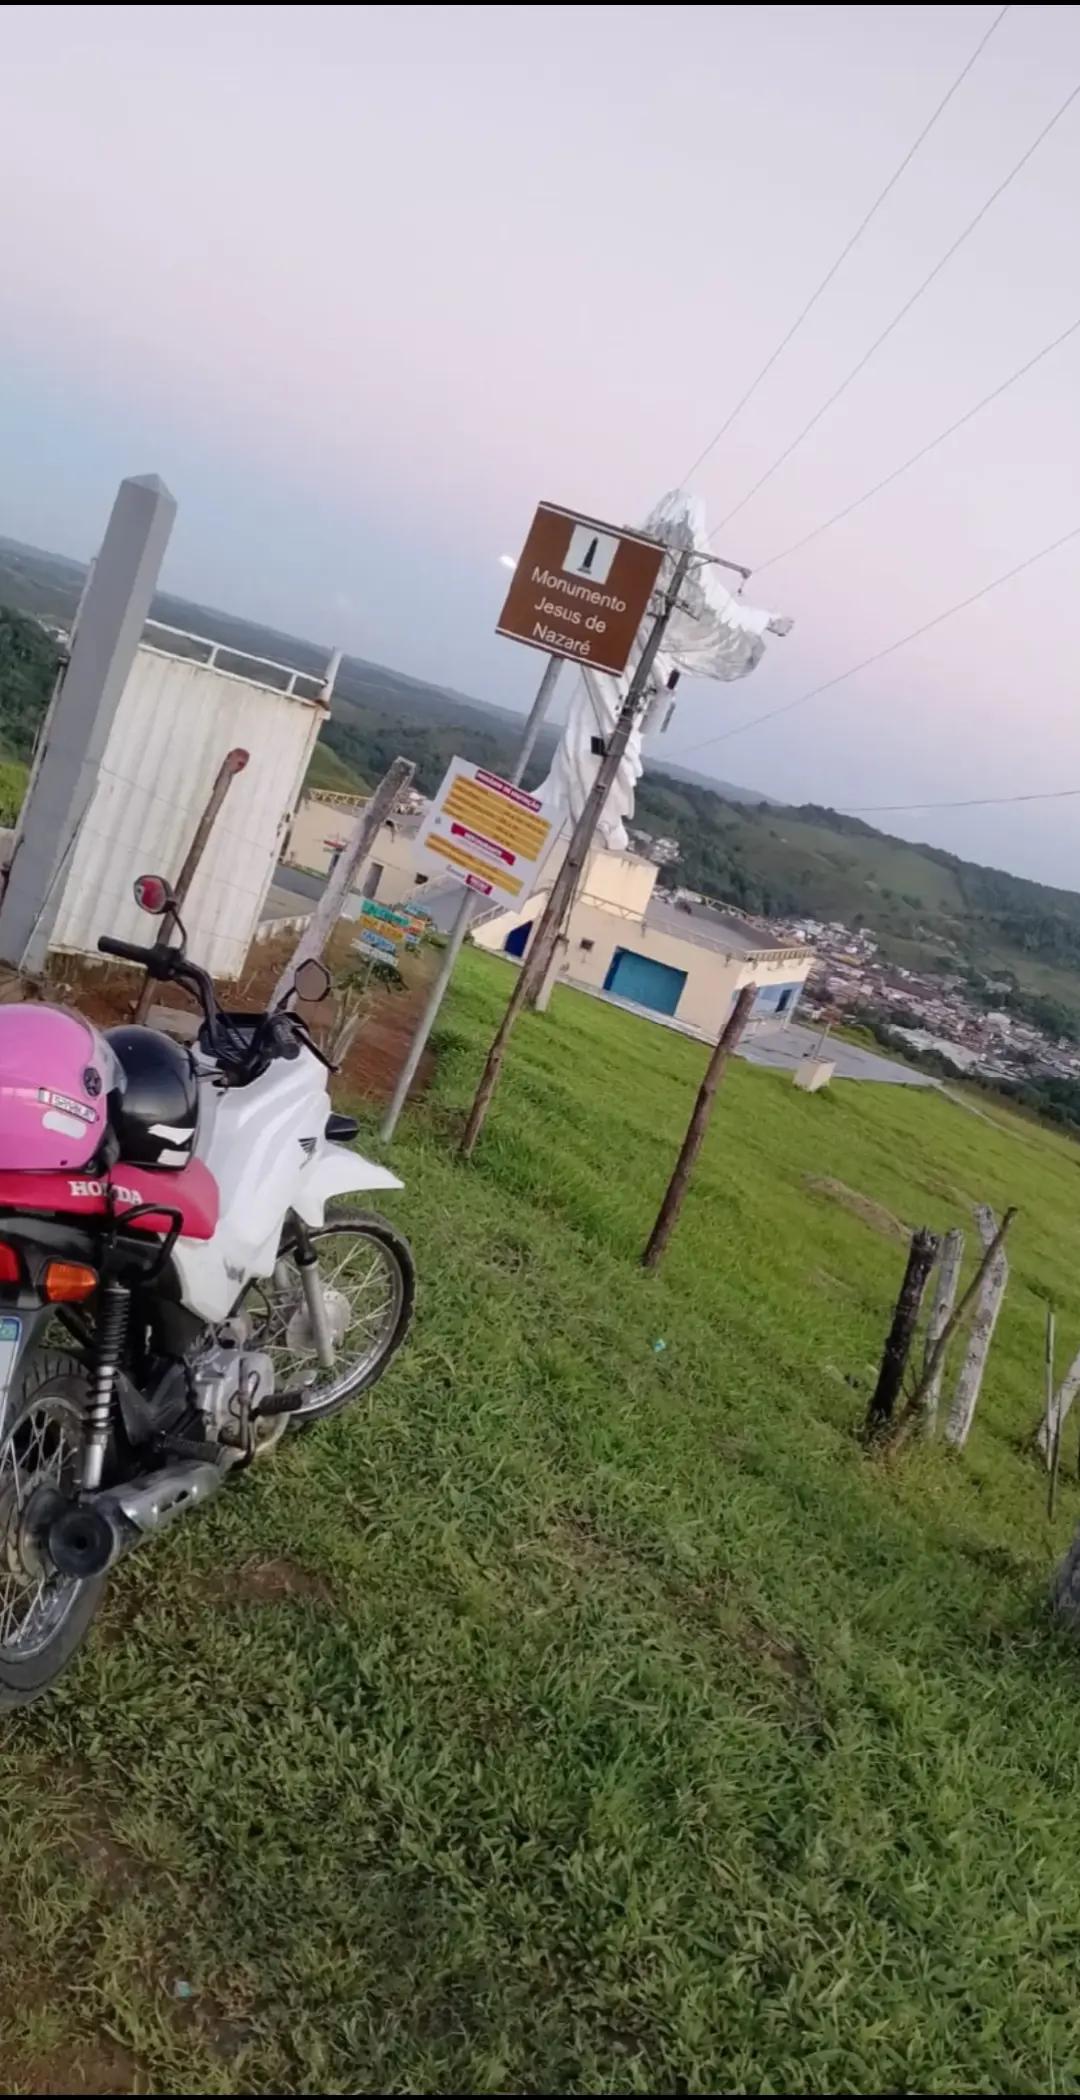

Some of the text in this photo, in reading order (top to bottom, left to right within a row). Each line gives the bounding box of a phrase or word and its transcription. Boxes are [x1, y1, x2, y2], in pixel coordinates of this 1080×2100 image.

[531, 565, 627, 613] Monumento
[533, 596, 607, 633] Jesus de
[531, 621, 591, 656] Nazaré
